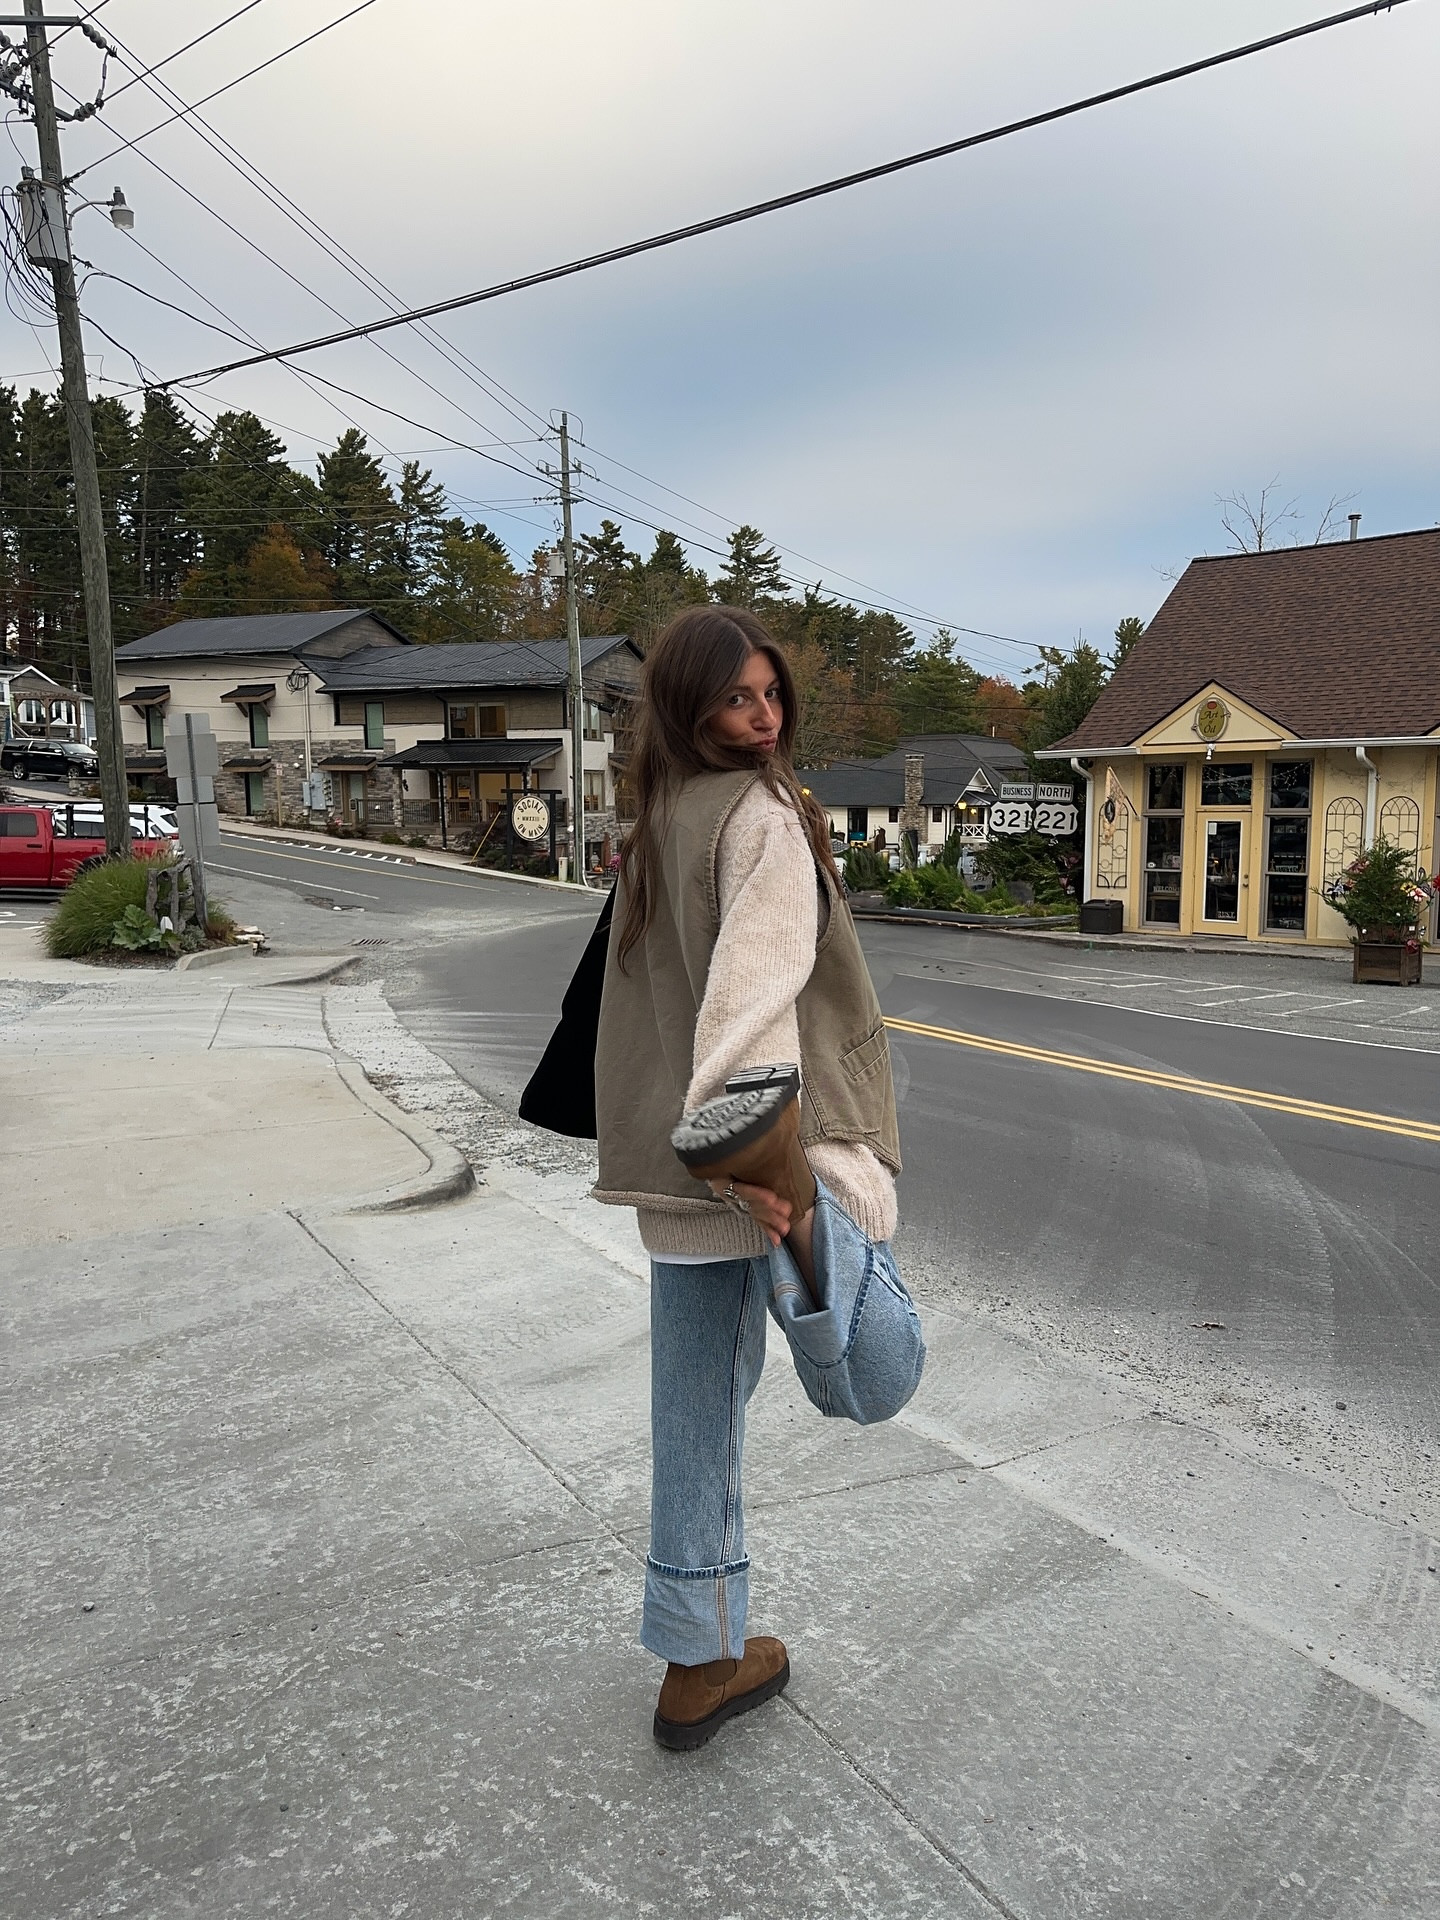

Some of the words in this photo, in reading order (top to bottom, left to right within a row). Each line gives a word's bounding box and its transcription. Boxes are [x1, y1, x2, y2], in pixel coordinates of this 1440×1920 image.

[1200, 711, 1218, 720] Art
[1204, 725, 1217, 733] Oil
[1002, 786, 1032, 796] BUSINESS
[1040, 786, 1071, 798] NORTH
[517, 799, 543, 814] SOCIAL
[993, 808, 1030, 828] 321
[1037, 810, 1075, 830] 221
[518, 823, 527, 834] ON
[528, 824, 544, 837] MAIN
